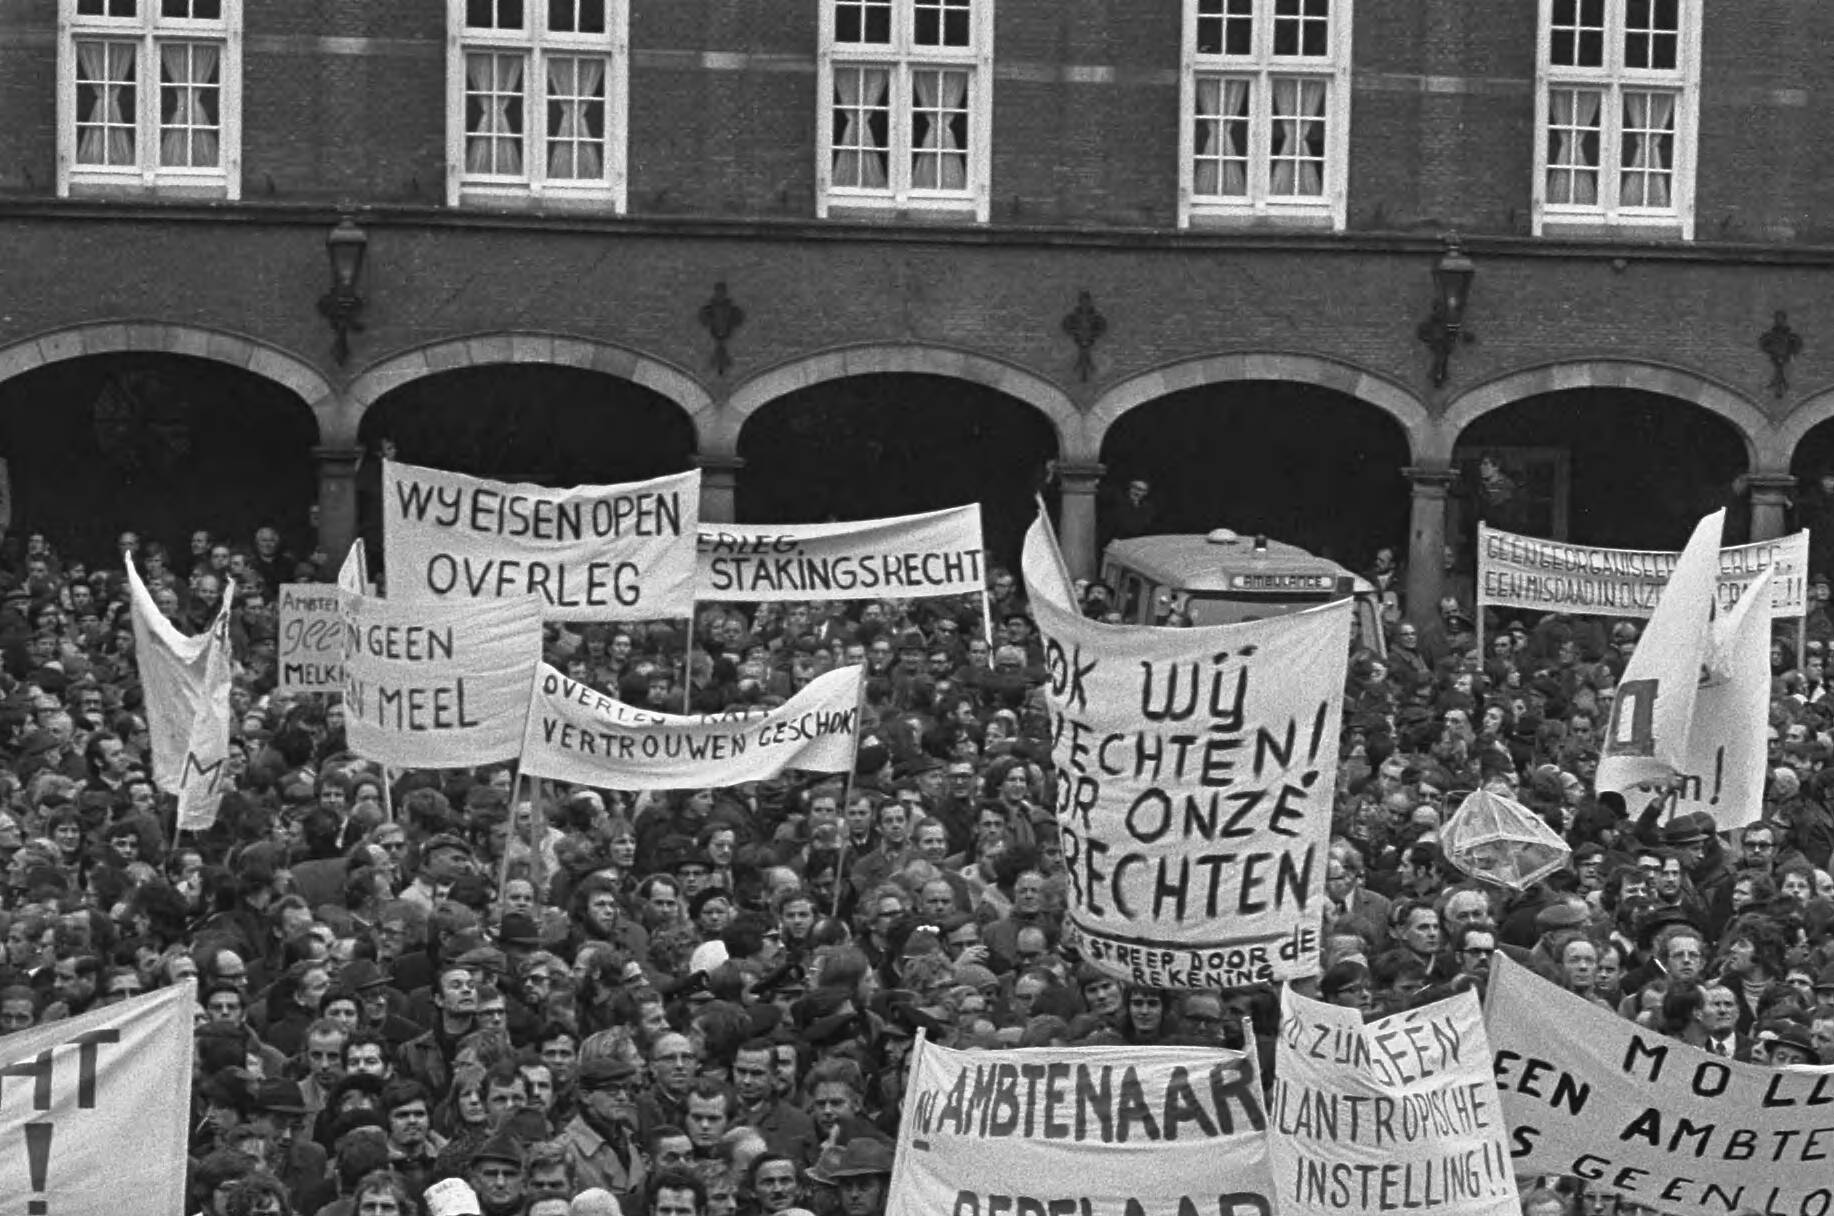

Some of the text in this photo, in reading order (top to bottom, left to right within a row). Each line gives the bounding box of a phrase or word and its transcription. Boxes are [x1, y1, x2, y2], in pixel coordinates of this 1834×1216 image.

[471, 488, 582, 541] EISEN
[592, 491, 681, 538] OPEN
[711, 550, 981, 592] STAKINGSRECHT
[368, 624, 454, 661] GEEN
[378, 677, 478, 732] MEEL
[543, 717, 746, 761] VERTROUWEN
[1063, 827, 1317, 922] RECHTEN
[1090, 938, 1175, 969] STREEP
[1190, 947, 1270, 972] DOOR
[937, 1059, 1267, 1143] AMBTENAAR
[1296, 1141, 1508, 1211] INSTELLING!!
[1571, 1152, 1746, 1212] GEEN
